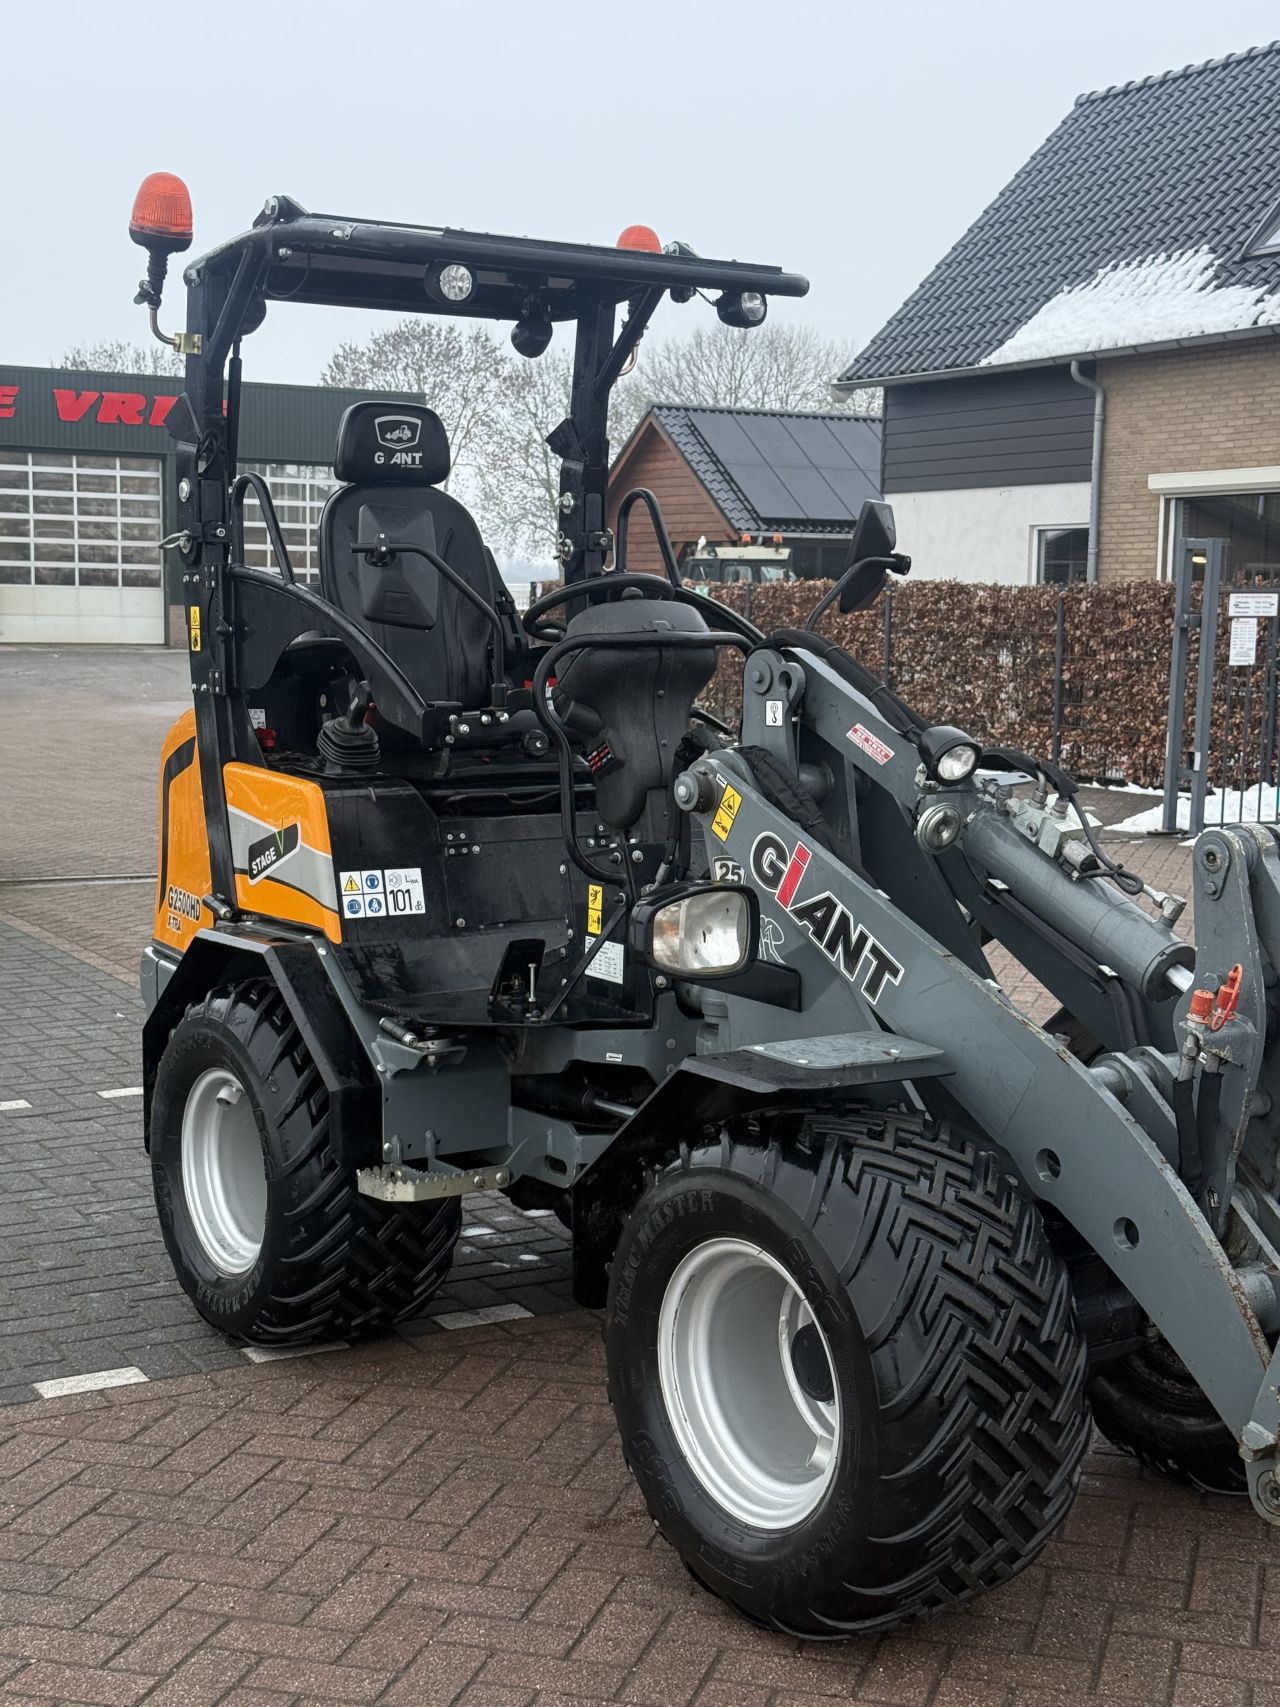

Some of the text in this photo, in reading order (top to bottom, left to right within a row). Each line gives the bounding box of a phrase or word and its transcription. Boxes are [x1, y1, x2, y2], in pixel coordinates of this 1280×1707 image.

[374, 451, 423, 465] GANT
[251, 846, 277, 875] STAGE
[719, 862, 742, 881] 25
[168, 885, 201, 922] G2500HD
[388, 888, 413, 912] 101
[637, 1188, 715, 1251] MASTER
